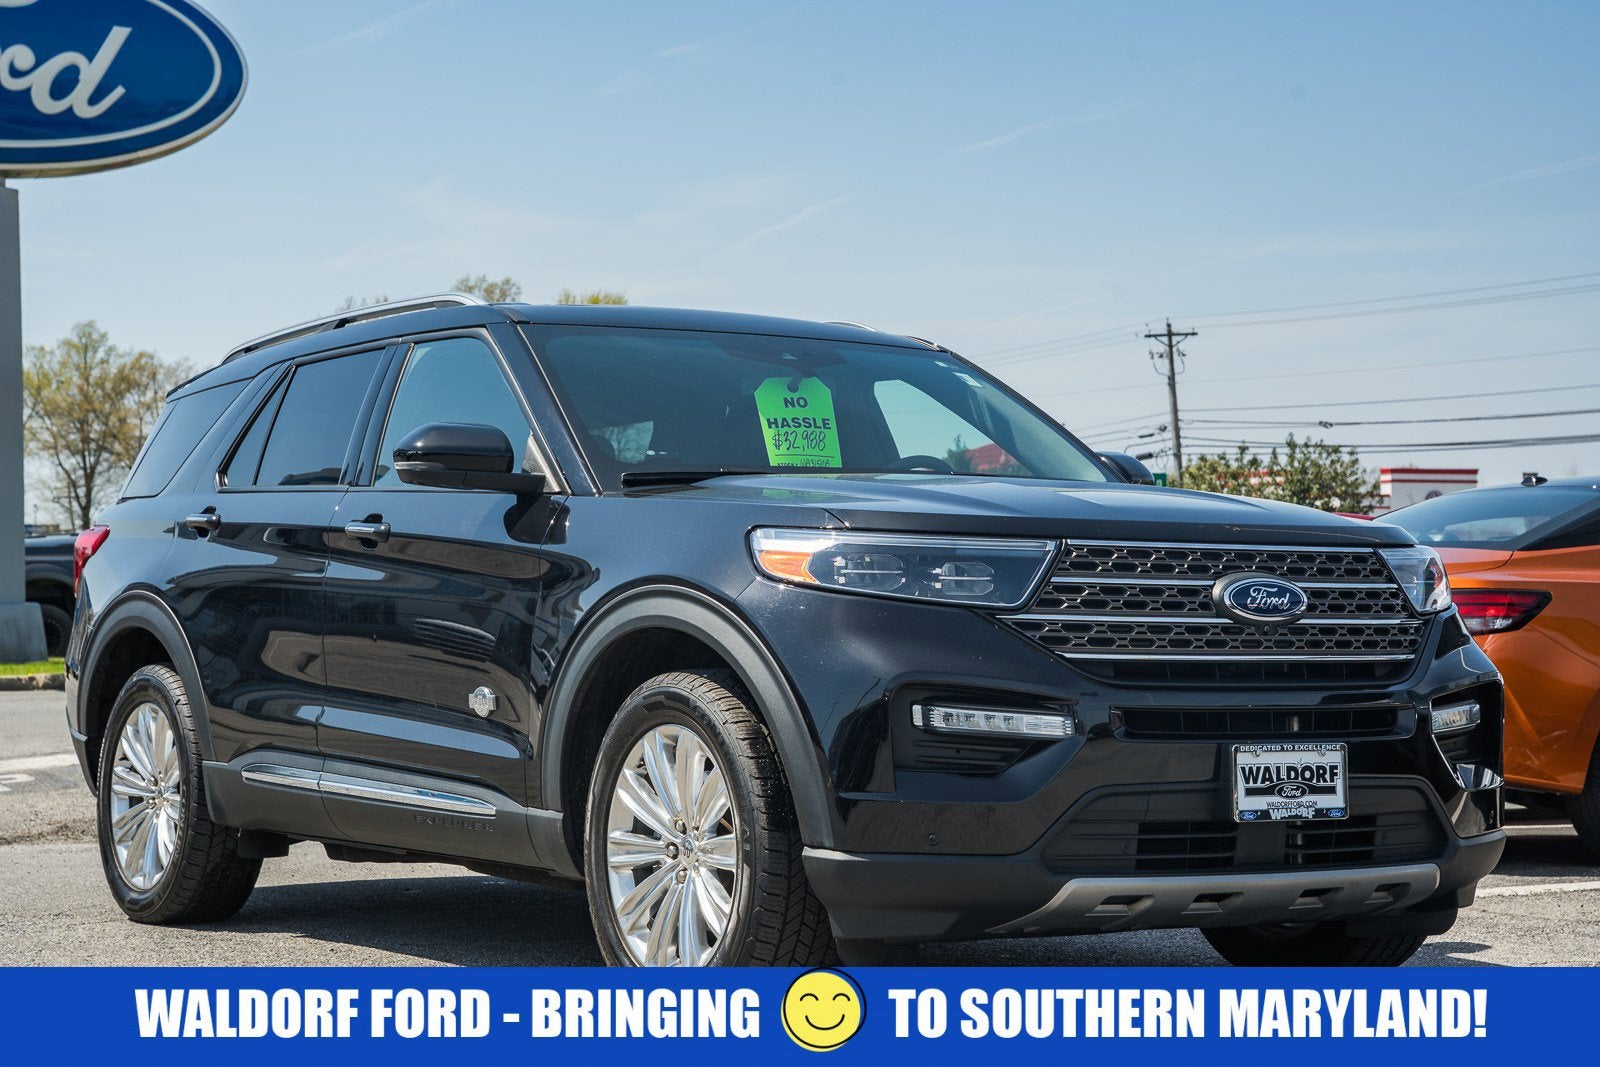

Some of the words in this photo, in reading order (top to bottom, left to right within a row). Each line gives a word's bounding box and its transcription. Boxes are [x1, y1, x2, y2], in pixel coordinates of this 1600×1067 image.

[782, 396, 809, 409] NO
[766, 416, 832, 430] HASSLE
[1246, 586, 1291, 610] Ford
[1240, 744, 1281, 752] DEDICATED
[1240, 764, 1339, 785] WALDORF
[1281, 785, 1302, 797] Ford
[1266, 800, 1318, 808] WALDORFFORD.COM
[1268, 807, 1316, 820] WALDORF
